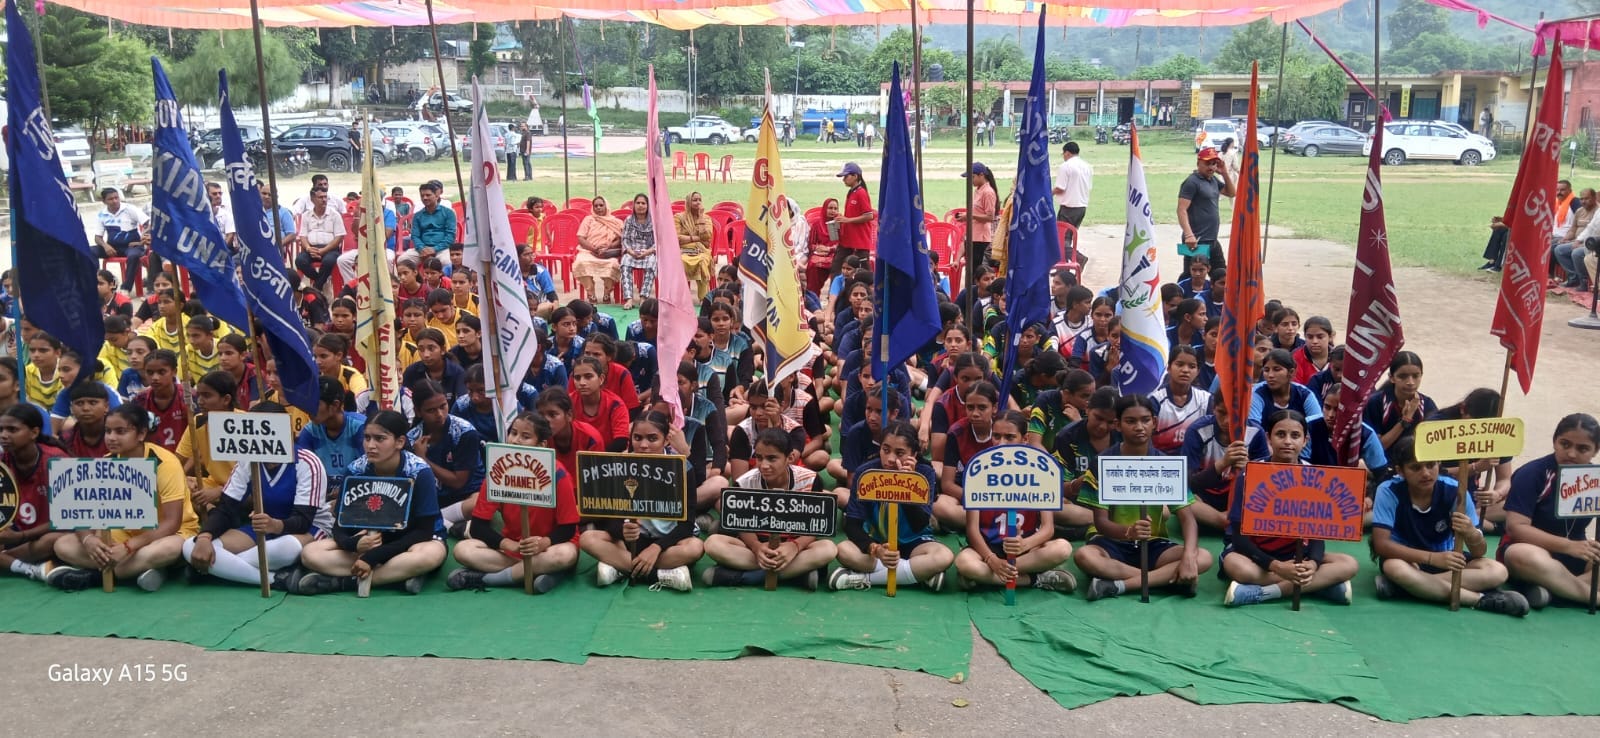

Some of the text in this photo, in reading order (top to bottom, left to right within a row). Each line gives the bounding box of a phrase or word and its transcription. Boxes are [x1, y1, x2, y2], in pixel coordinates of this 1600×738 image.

[176, 226, 229, 274] UNA
[223, 418, 276, 436] G.H.S.
[295, 417, 302, 431] 8
[163, 427, 176, 446] 2
[216, 438, 288, 456] JASANA
[1456, 440, 1494, 454] BALH
[330, 453, 345, 468] 20
[969, 450, 1055, 477] G.S.S.S.
[1075, 456, 1089, 472] 19
[76, 463, 93, 482] SR.
[601, 462, 628, 477] SHRI
[987, 474, 1040, 487] BOUL
[74, 488, 132, 501] KIARIAN
[875, 490, 912, 501] BUDHAN
[1270, 468, 1298, 491] SEN.
[1325, 477, 1360, 520] SCHOOL
[19, 502, 37, 525] 9
[789, 498, 825, 514] School
[1273, 498, 1333, 520] BANGANA
[61, 509, 145, 520] DISTT. UNA H.P.
